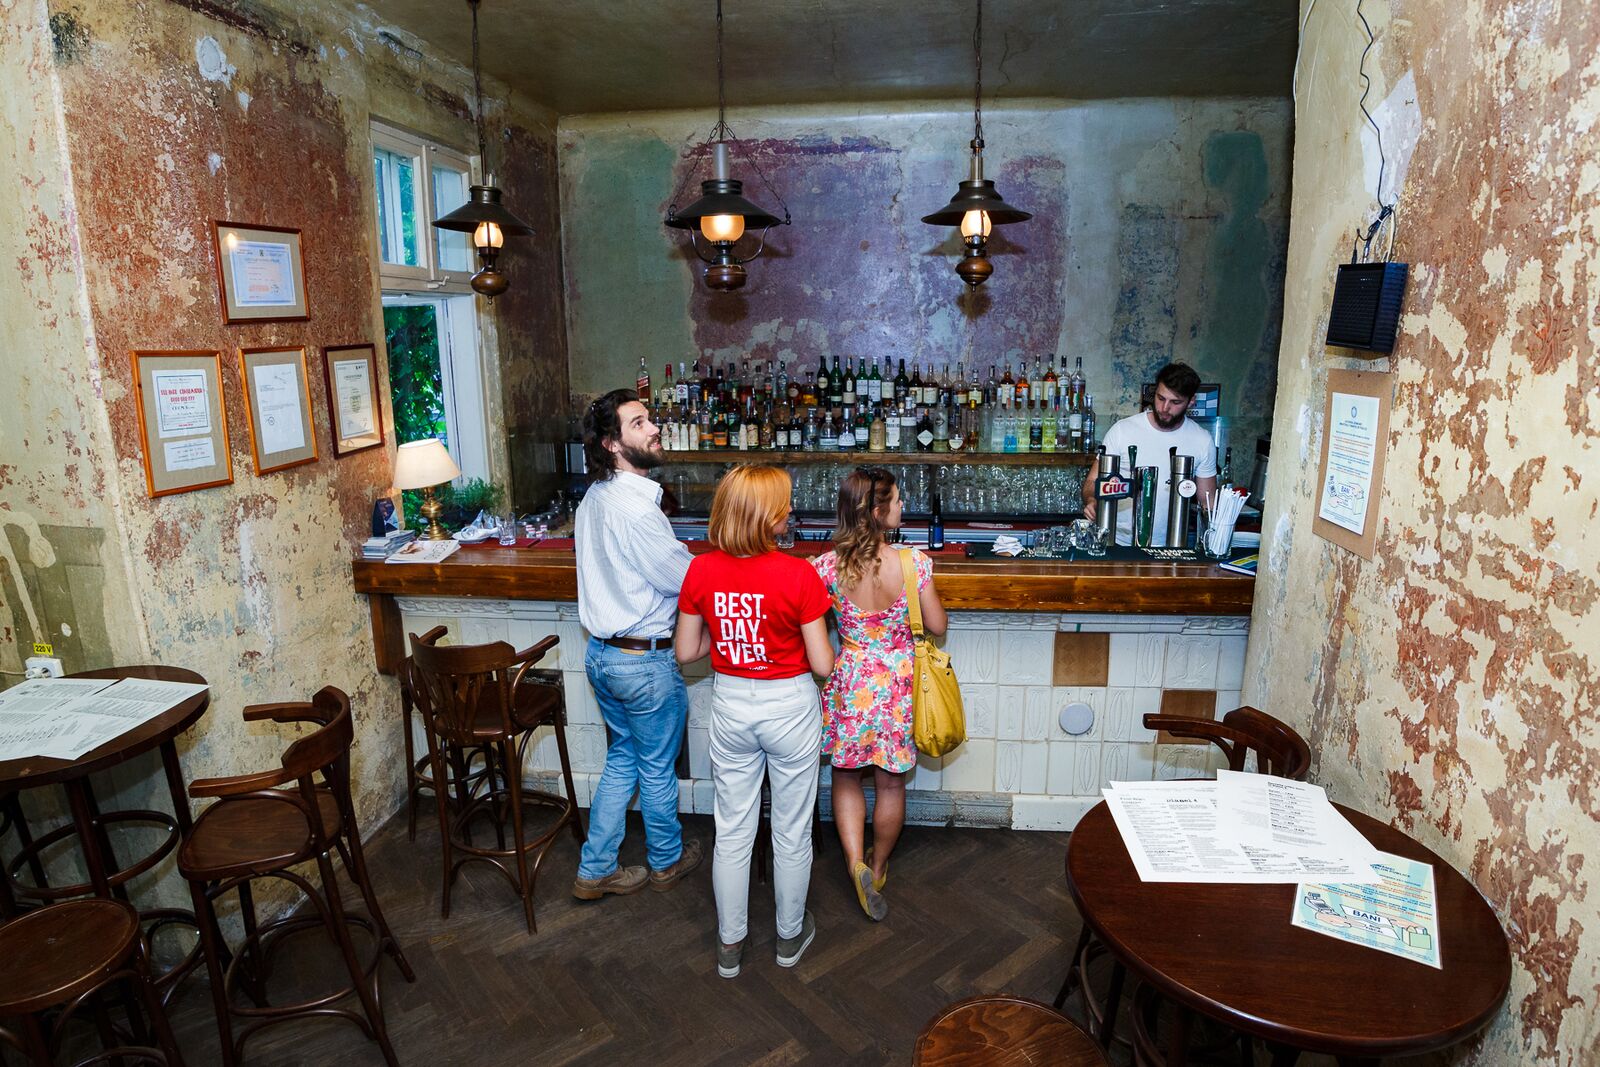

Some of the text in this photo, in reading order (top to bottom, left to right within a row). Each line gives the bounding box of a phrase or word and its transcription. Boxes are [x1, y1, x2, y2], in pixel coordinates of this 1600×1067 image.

[714, 592, 767, 619] BEST.
[720, 619, 764, 643] DAY.
[1353, 909, 1381, 923] BANI
